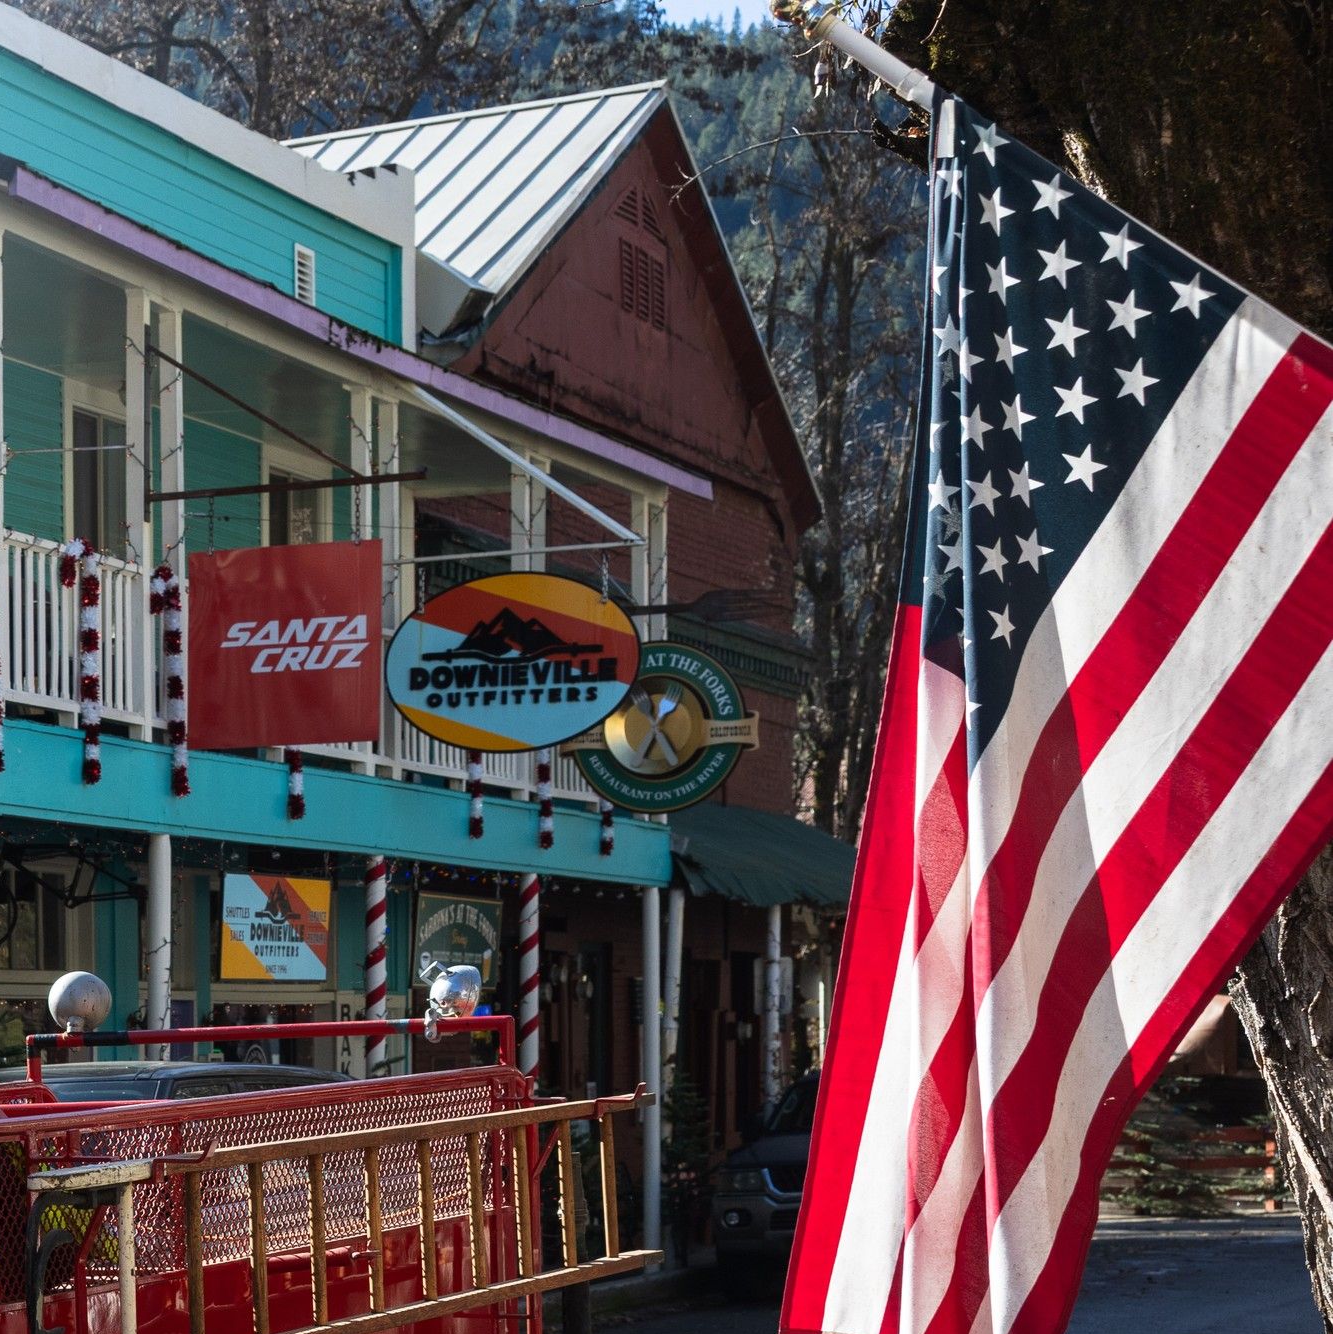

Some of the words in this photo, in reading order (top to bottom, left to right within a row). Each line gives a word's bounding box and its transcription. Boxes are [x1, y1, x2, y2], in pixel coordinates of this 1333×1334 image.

[220, 614, 368, 648] SANTA
[250, 642, 370, 674] CRUZ
[409, 657, 617, 691] DOWNIEVILLE
[646, 653, 667, 668] AT
[669, 653, 701, 676] THE
[698, 668, 734, 716] FORKS
[426, 686, 598, 708] OUTFITTERS
[588, 755, 656, 801] RESTAURANT
[653, 790, 673, 801] ON
[673, 781, 698, 797] THE
[698, 751, 727, 785] RIVER
[225, 906, 250, 919] SHUTTLES
[465, 904, 479, 930] THE
[230, 930, 245, 942] SALES
[250, 922, 305, 943] DOWNIEVILLE
[254, 944, 299, 957] OUTFITTERS
